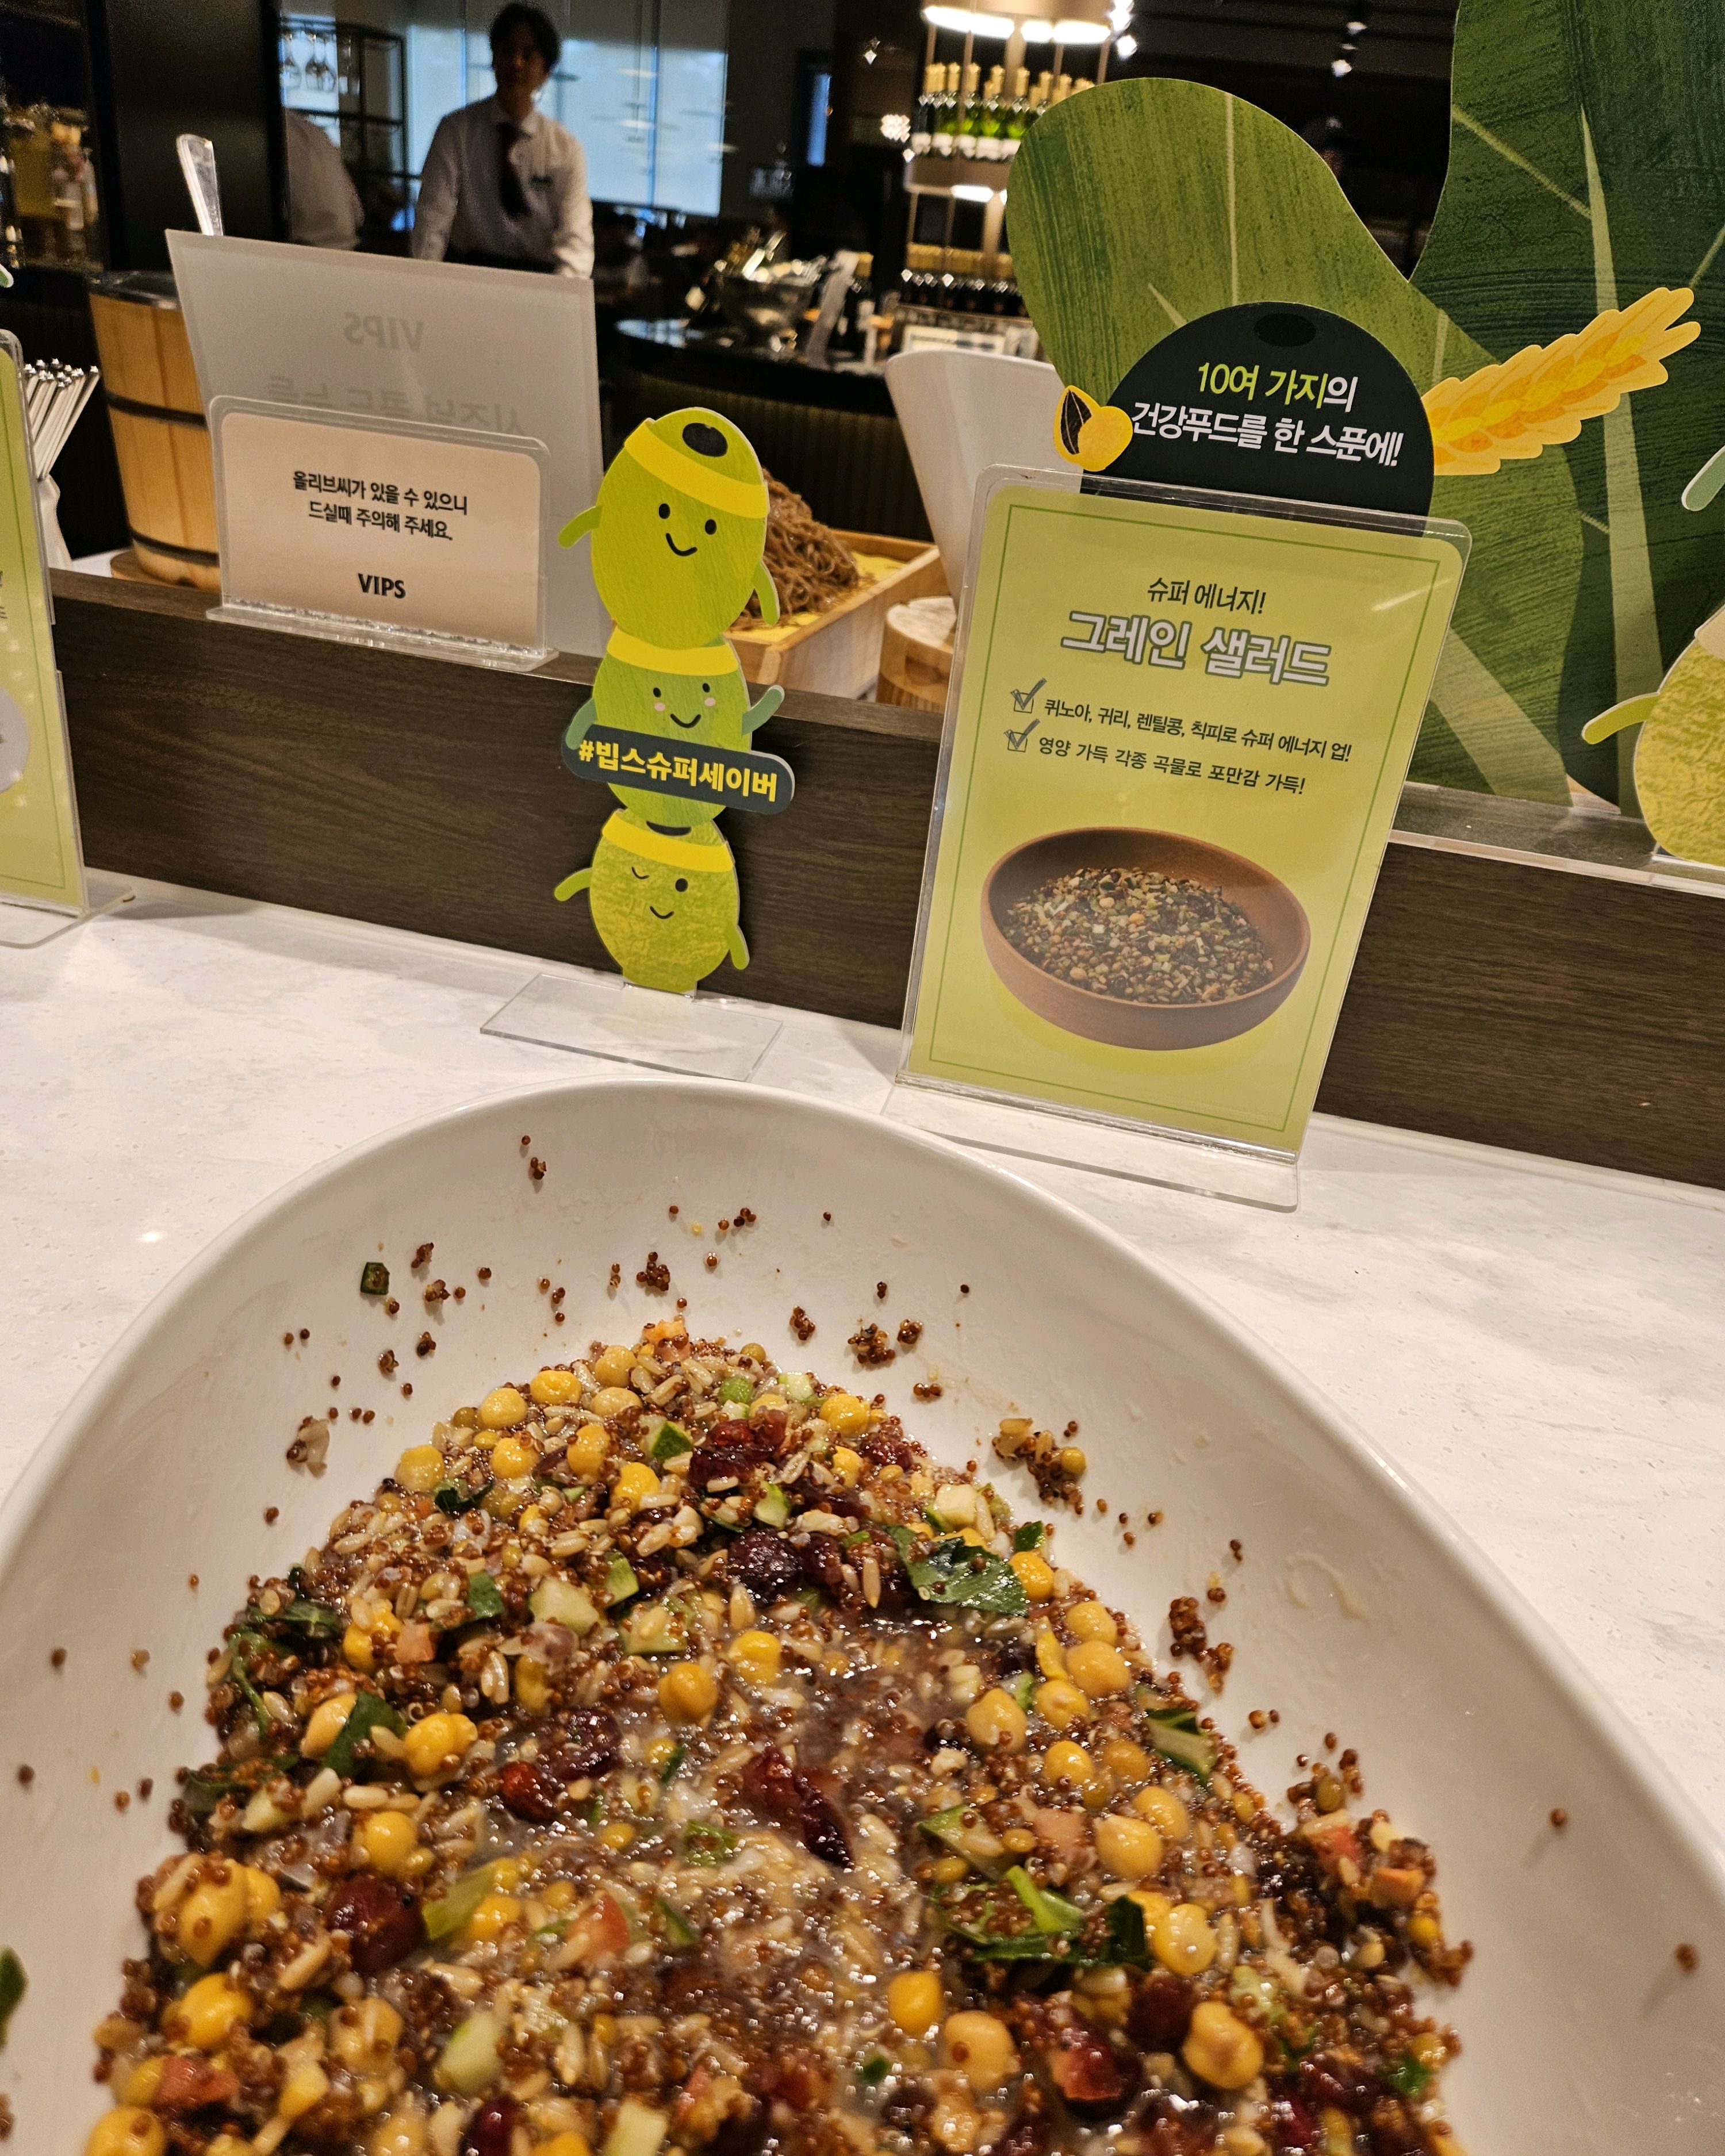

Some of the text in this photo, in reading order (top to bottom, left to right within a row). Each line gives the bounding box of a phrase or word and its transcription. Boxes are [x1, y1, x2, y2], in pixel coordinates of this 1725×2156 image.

[1198, 362, 1359, 412] 10여 가지의
[1131, 402, 1404, 466] 건강푸드를 한 스푼에!
[293, 470, 468, 516] 올리브씨가 있을 수 있으니
[309, 500, 454, 541] 드실때 주의해 주세요.
[358, 573, 407, 599] VIPS
[1147, 577, 1267, 615] 슈퍼 에너지!
[1061, 610, 1331, 686] 그레인 샐러드
[1044, 699, 1352, 762] 퀴노아, 귀리, 렌틸콩, 칙피로 슈퍼 에너지 업!
[578, 739, 777, 803] #빕스슈퍼세이버
[1039, 736, 1306, 795] 영양 가득 각종 곡물로 포만감 가득!
